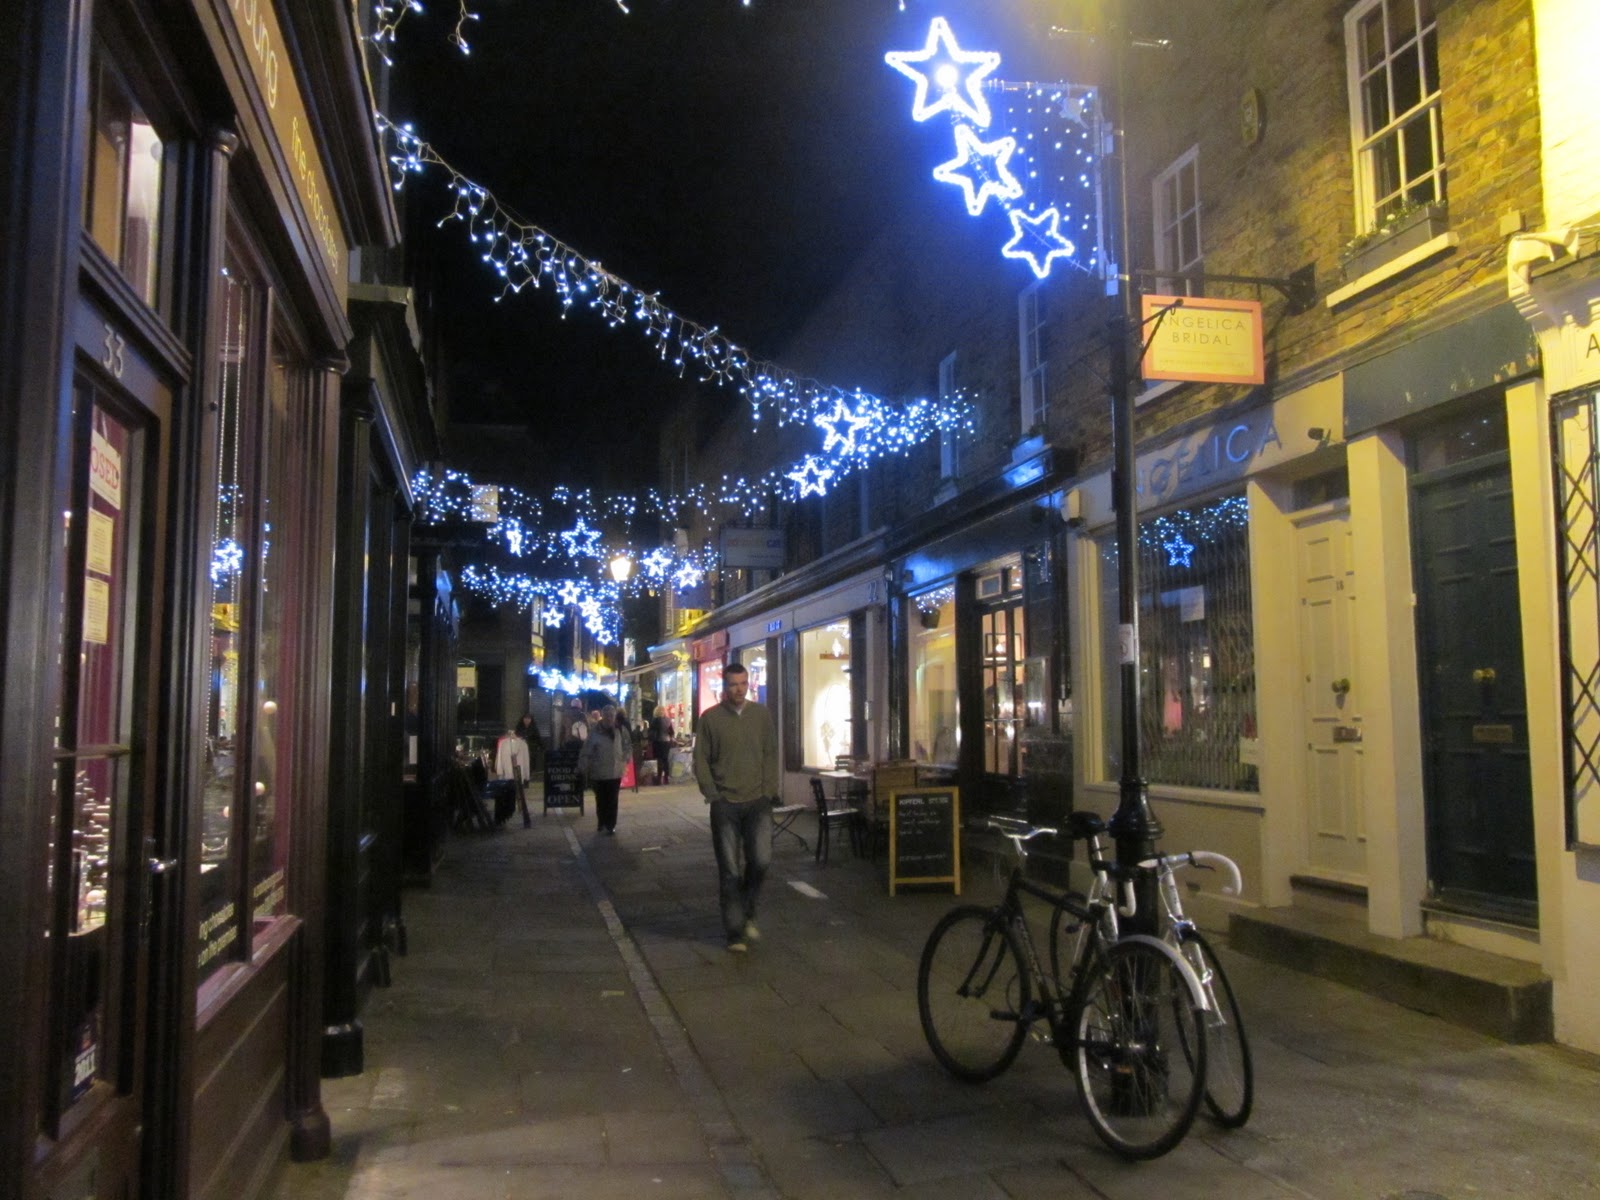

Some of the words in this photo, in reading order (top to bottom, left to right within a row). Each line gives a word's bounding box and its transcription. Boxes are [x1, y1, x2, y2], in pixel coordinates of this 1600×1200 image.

[235, 0, 278, 108] oung
[103, 323, 124, 379] 33
[1172, 332, 1231, 345] BRIDAL
[547, 795, 580, 805] OPEN
